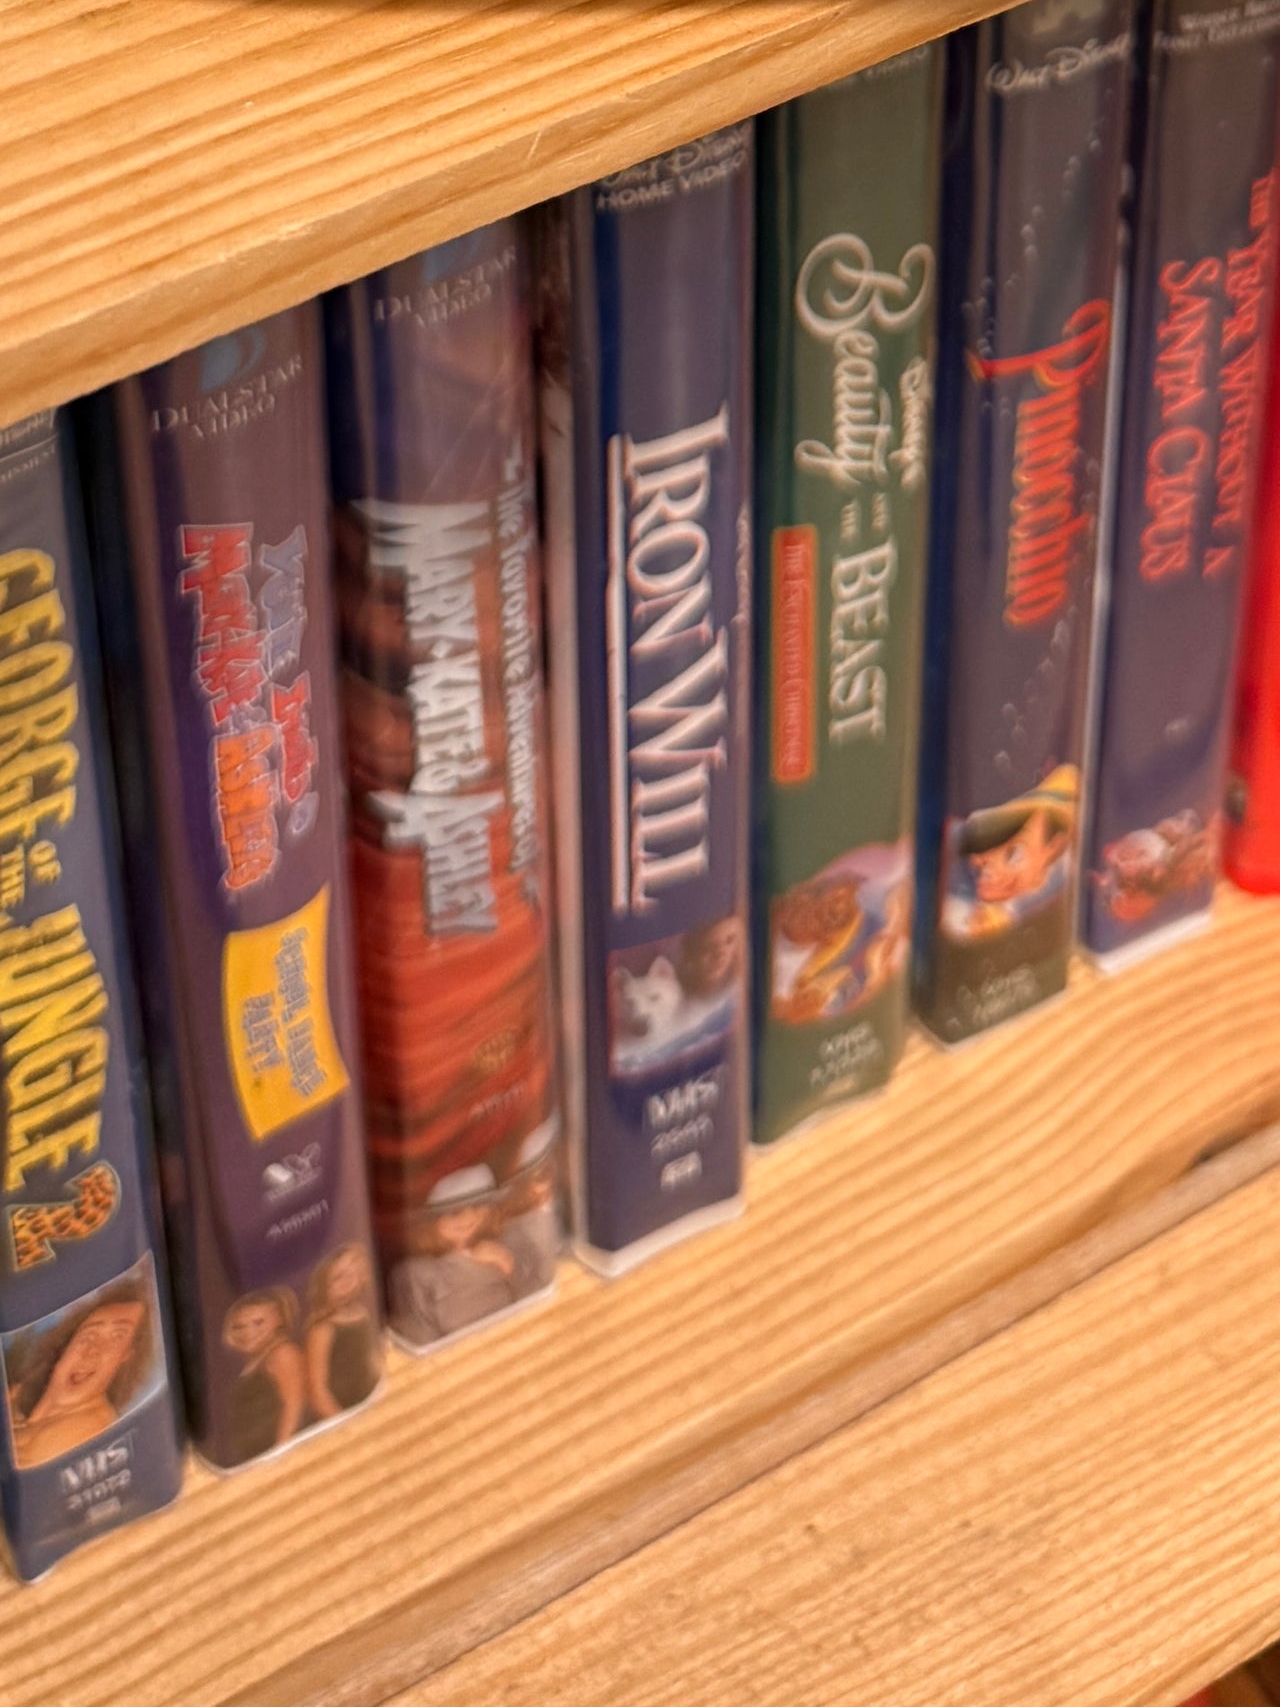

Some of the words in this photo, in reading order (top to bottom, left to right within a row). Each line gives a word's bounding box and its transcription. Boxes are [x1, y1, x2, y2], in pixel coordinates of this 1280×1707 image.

[795, 232, 936, 485] Beauty
[964, 297, 1111, 626] Pinocchio
[1153, 256, 1222, 420] SANTA
[625, 402, 729, 652] IRON
[829, 533, 898, 744] BEAST
[628, 623, 729, 916] WILL
[3, 1159, 122, 1273] 2
